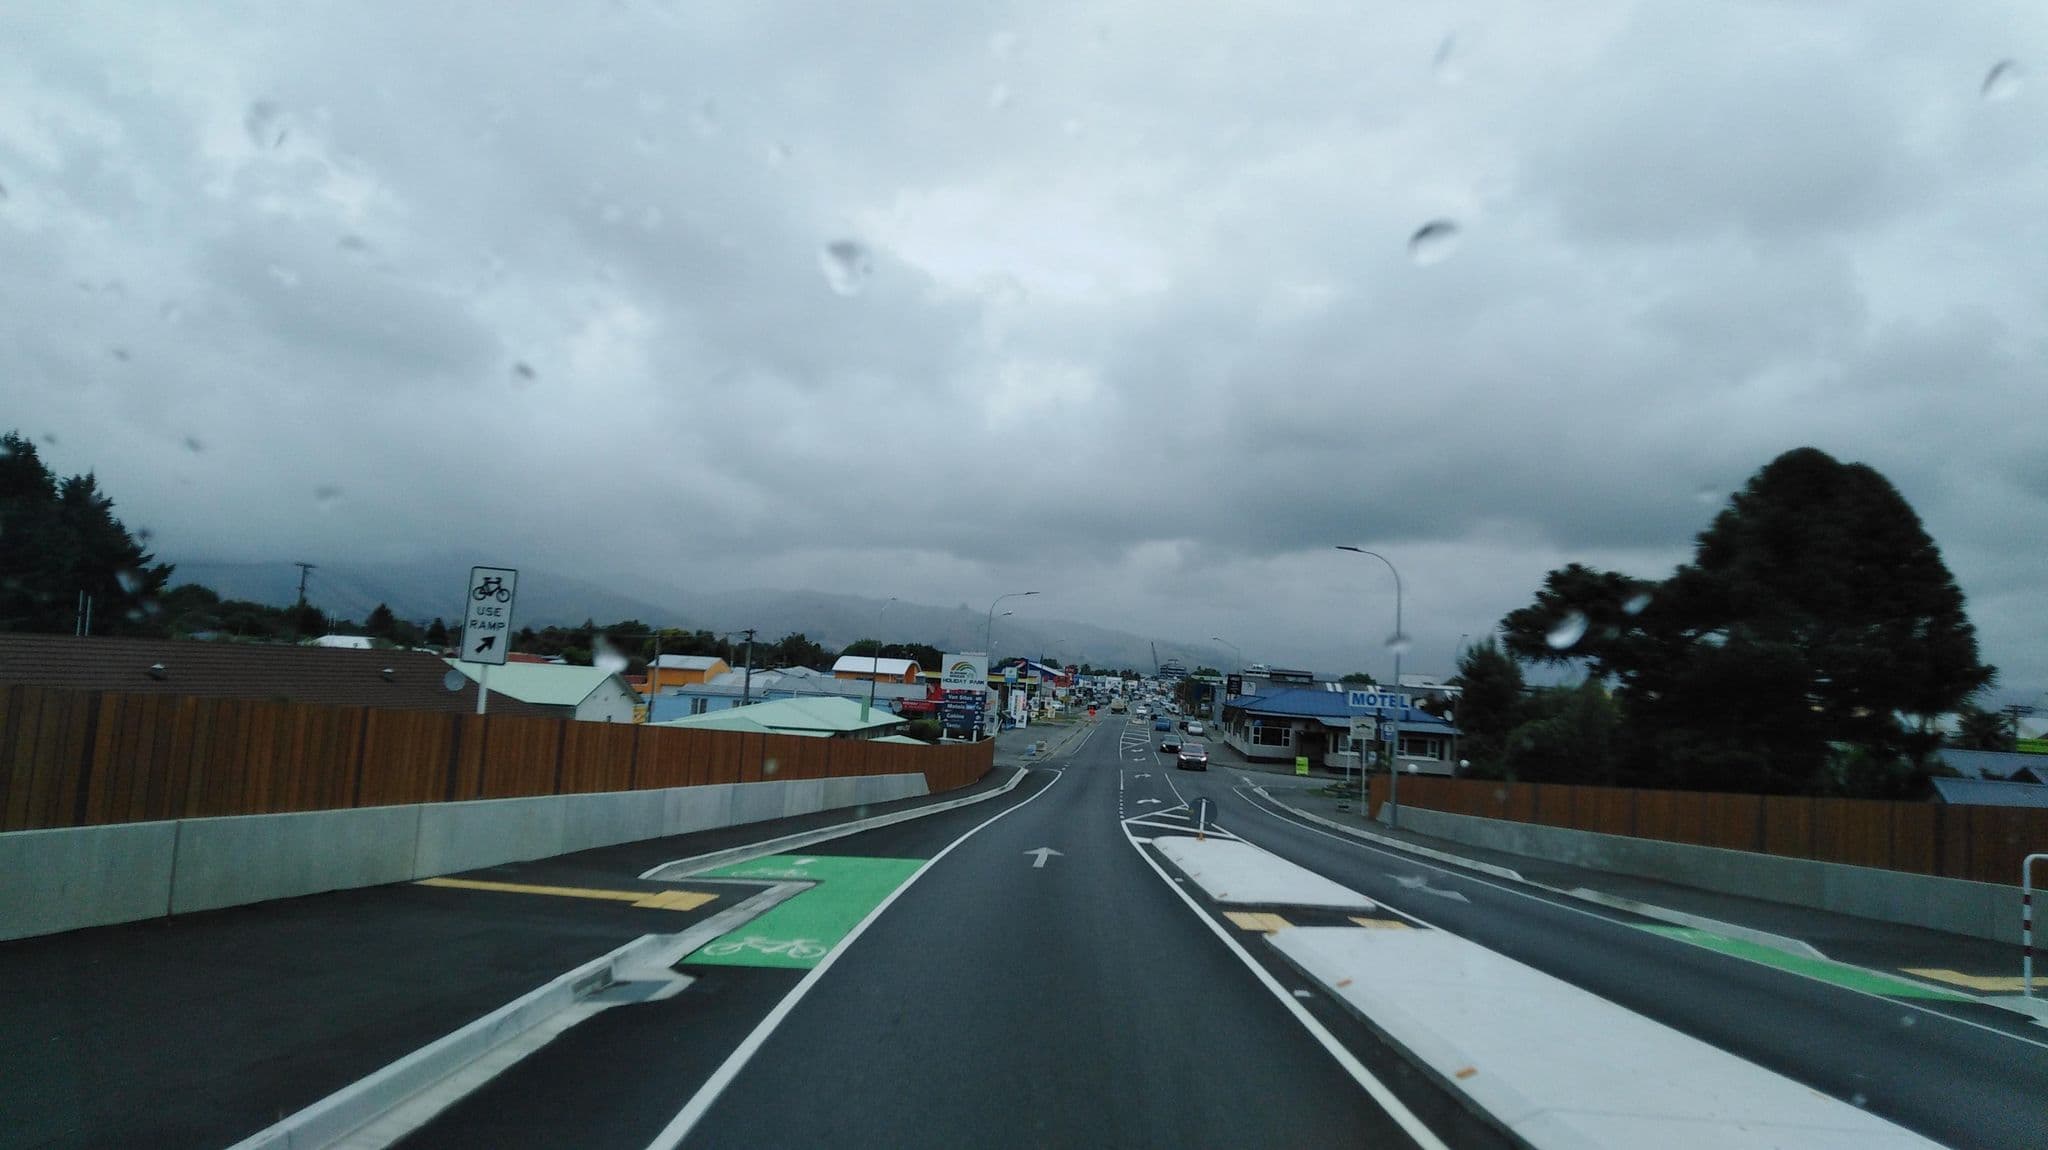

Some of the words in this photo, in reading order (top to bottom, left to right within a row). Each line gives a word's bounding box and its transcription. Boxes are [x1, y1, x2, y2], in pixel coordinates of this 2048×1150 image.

[476, 607, 503, 617] USE
[469, 620, 506, 631] RAMP
[1352, 693, 1409, 708] MOTEL
